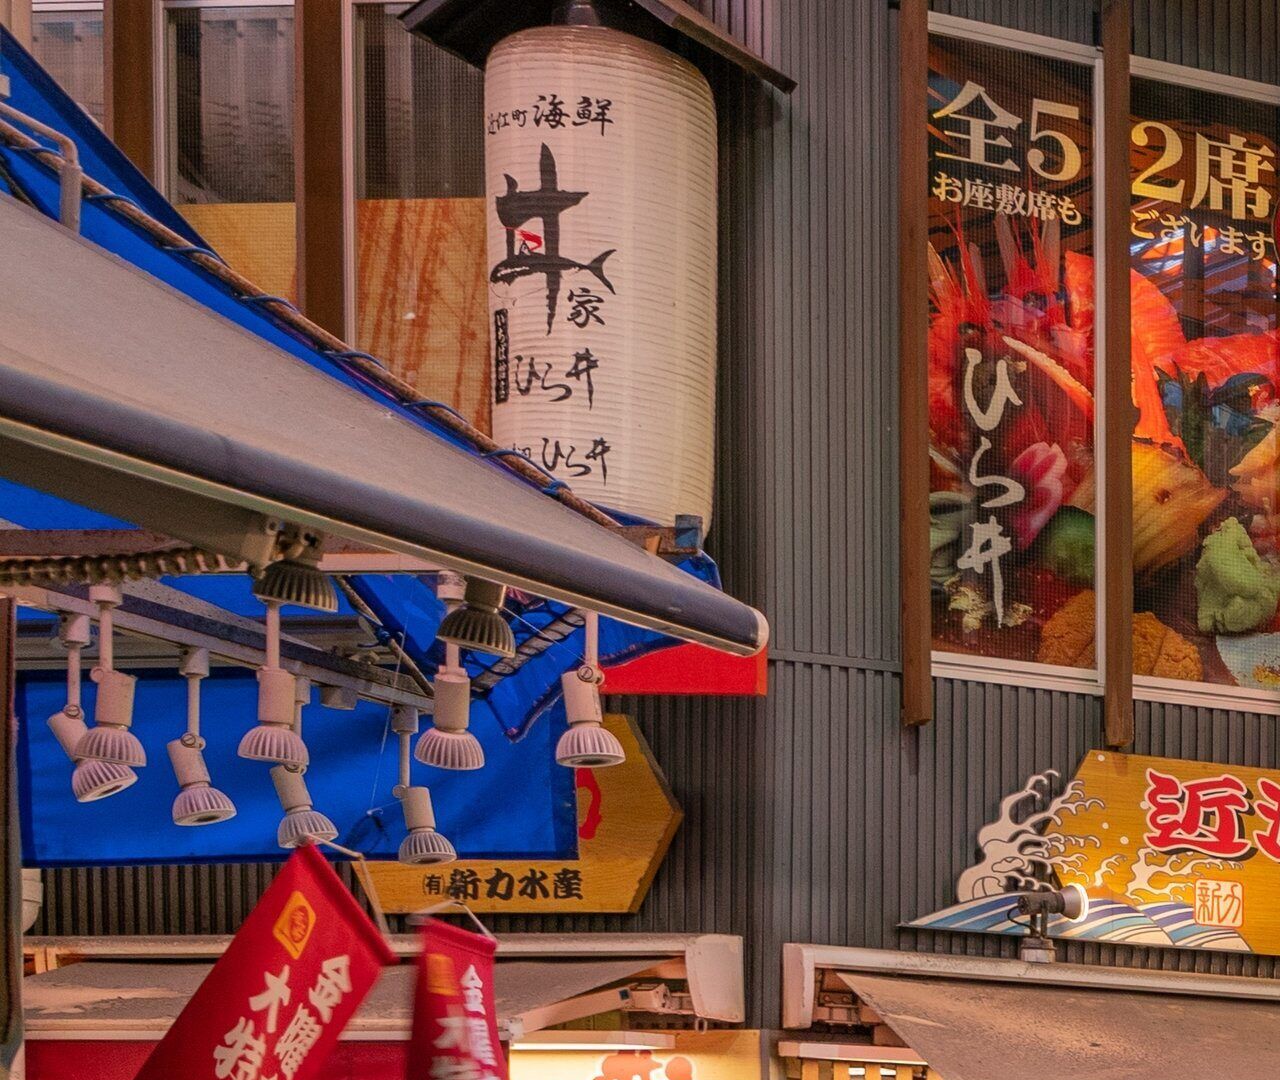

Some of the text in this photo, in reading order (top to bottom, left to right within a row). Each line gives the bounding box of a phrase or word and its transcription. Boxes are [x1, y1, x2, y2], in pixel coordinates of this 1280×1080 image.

[932, 172, 1275, 261] お座敷席も ございます
[957, 348, 1026, 629] ひら井
